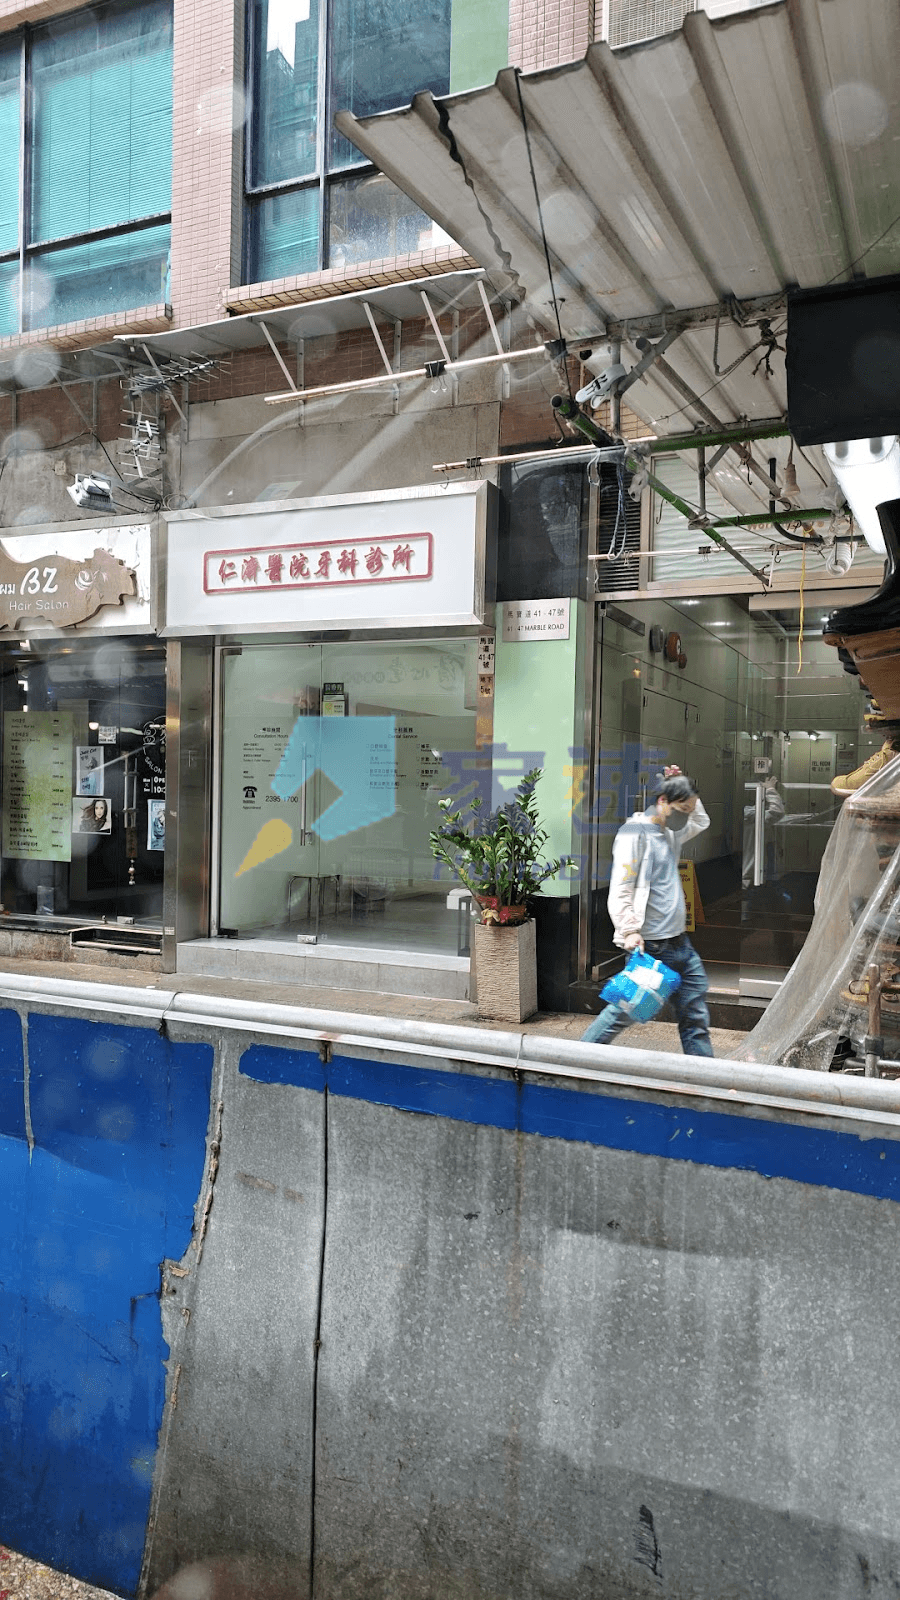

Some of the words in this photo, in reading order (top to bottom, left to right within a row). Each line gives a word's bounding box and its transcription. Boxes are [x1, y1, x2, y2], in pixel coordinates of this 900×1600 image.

[218, 543, 414, 585] 仁濟醫院牙科診所
[9, 601, 31, 611] Hair
[35, 599, 69, 610] Salon
[144, 756, 163, 775] SALON
